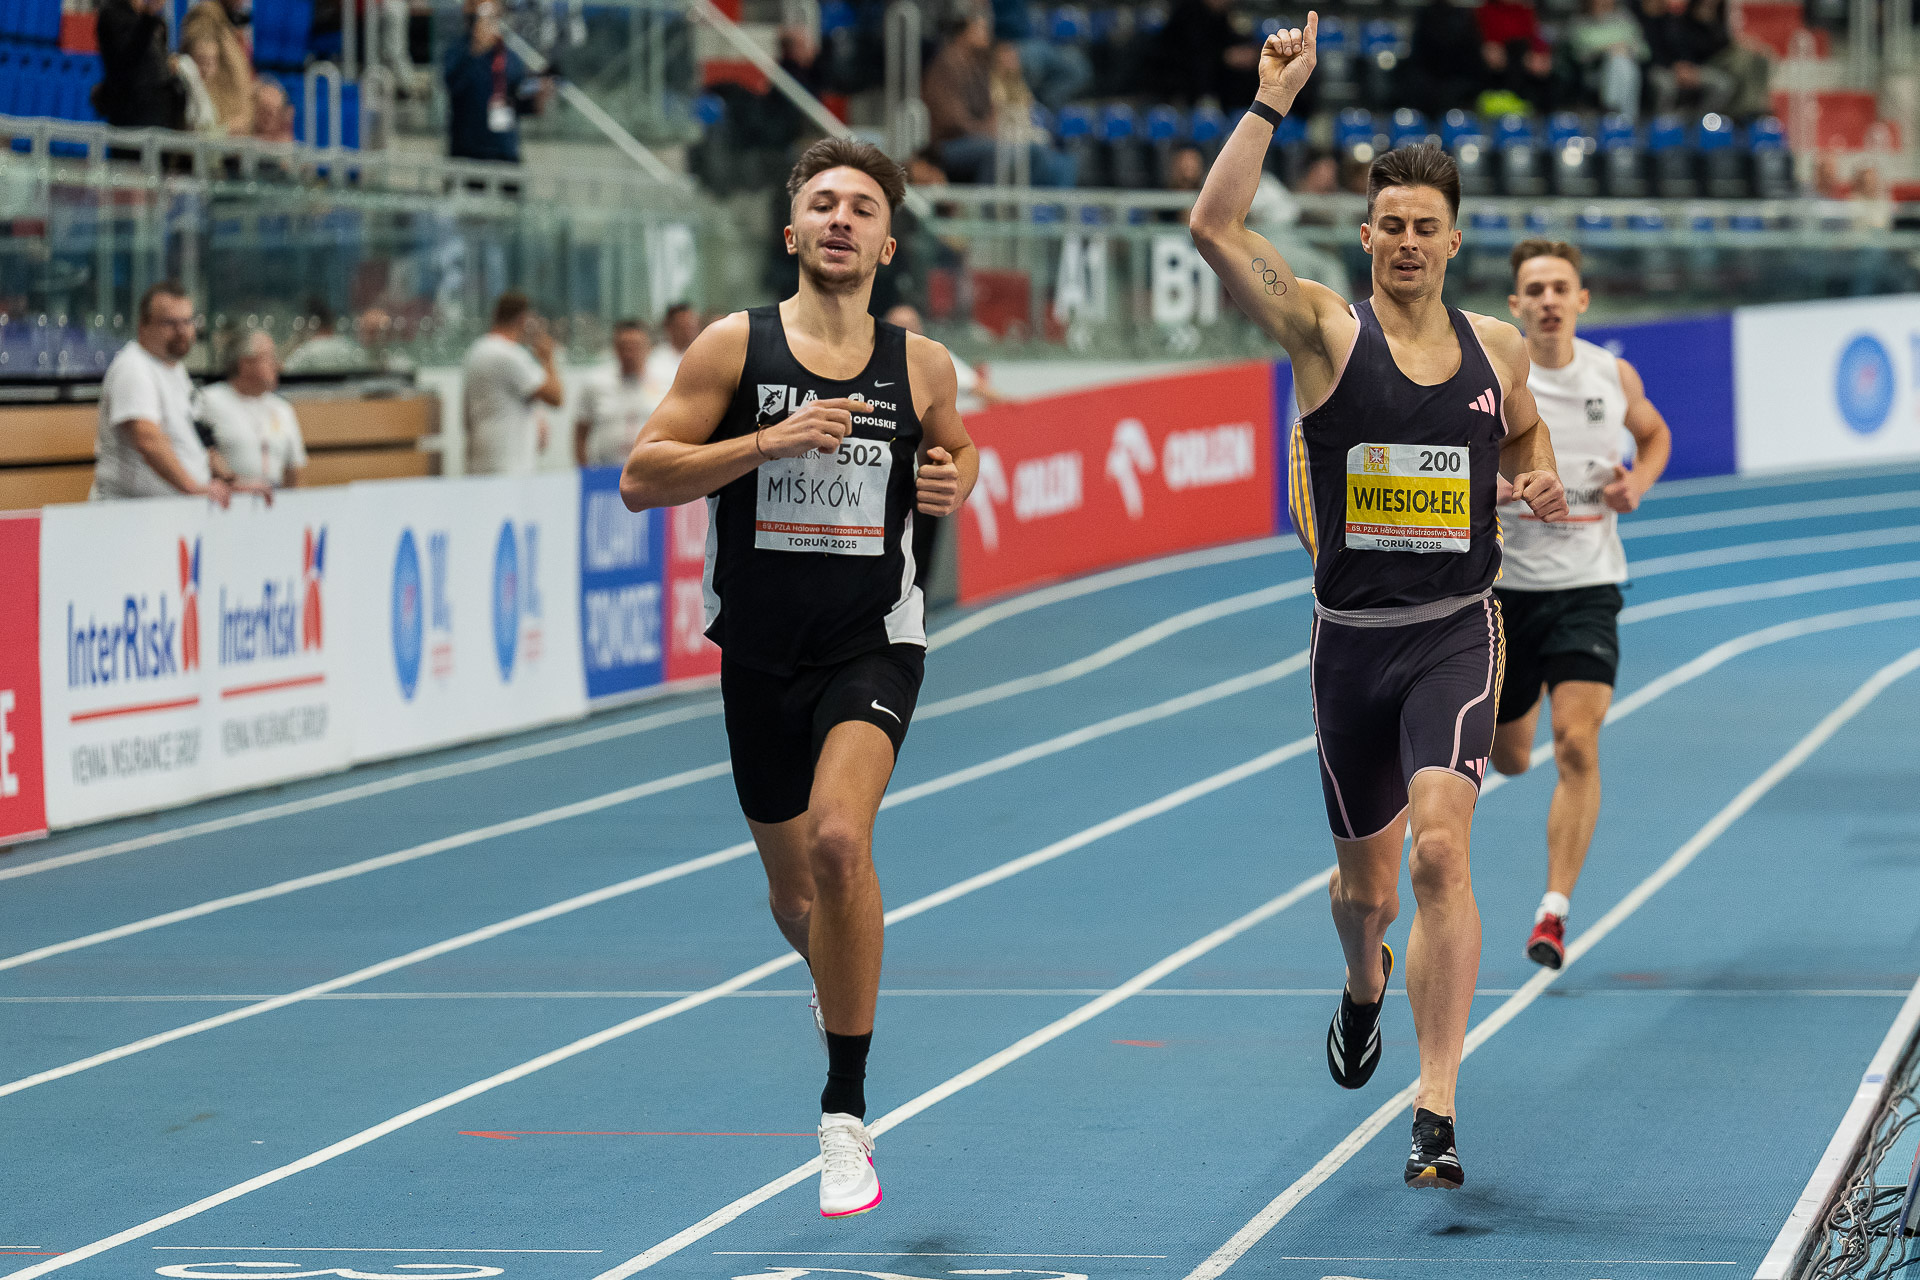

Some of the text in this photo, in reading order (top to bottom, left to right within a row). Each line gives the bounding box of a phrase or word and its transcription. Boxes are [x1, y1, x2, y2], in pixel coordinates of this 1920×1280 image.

[867, 399, 897, 411] OPOLE
[853, 415, 897, 430] OPOLSKIE
[836, 444, 882, 467] 502
[1418, 450, 1461, 472] 200
[1353, 486, 1466, 515] WIESIOŁEK
[762, 522, 882, 536] 69. PZLA Halowe Mistrzostwa Polski
[1351, 525, 1362, 533] 69.
[1380, 526, 1406, 535] Halowe
[1406, 528, 1447, 537] Mistrzostwa
[1448, 530, 1467, 538] Polski
[787, 536, 857, 549] TORUŃ 2025
[1375, 538, 1442, 549] TORUŃ 2025
[67, 591, 177, 690] InterRisk
